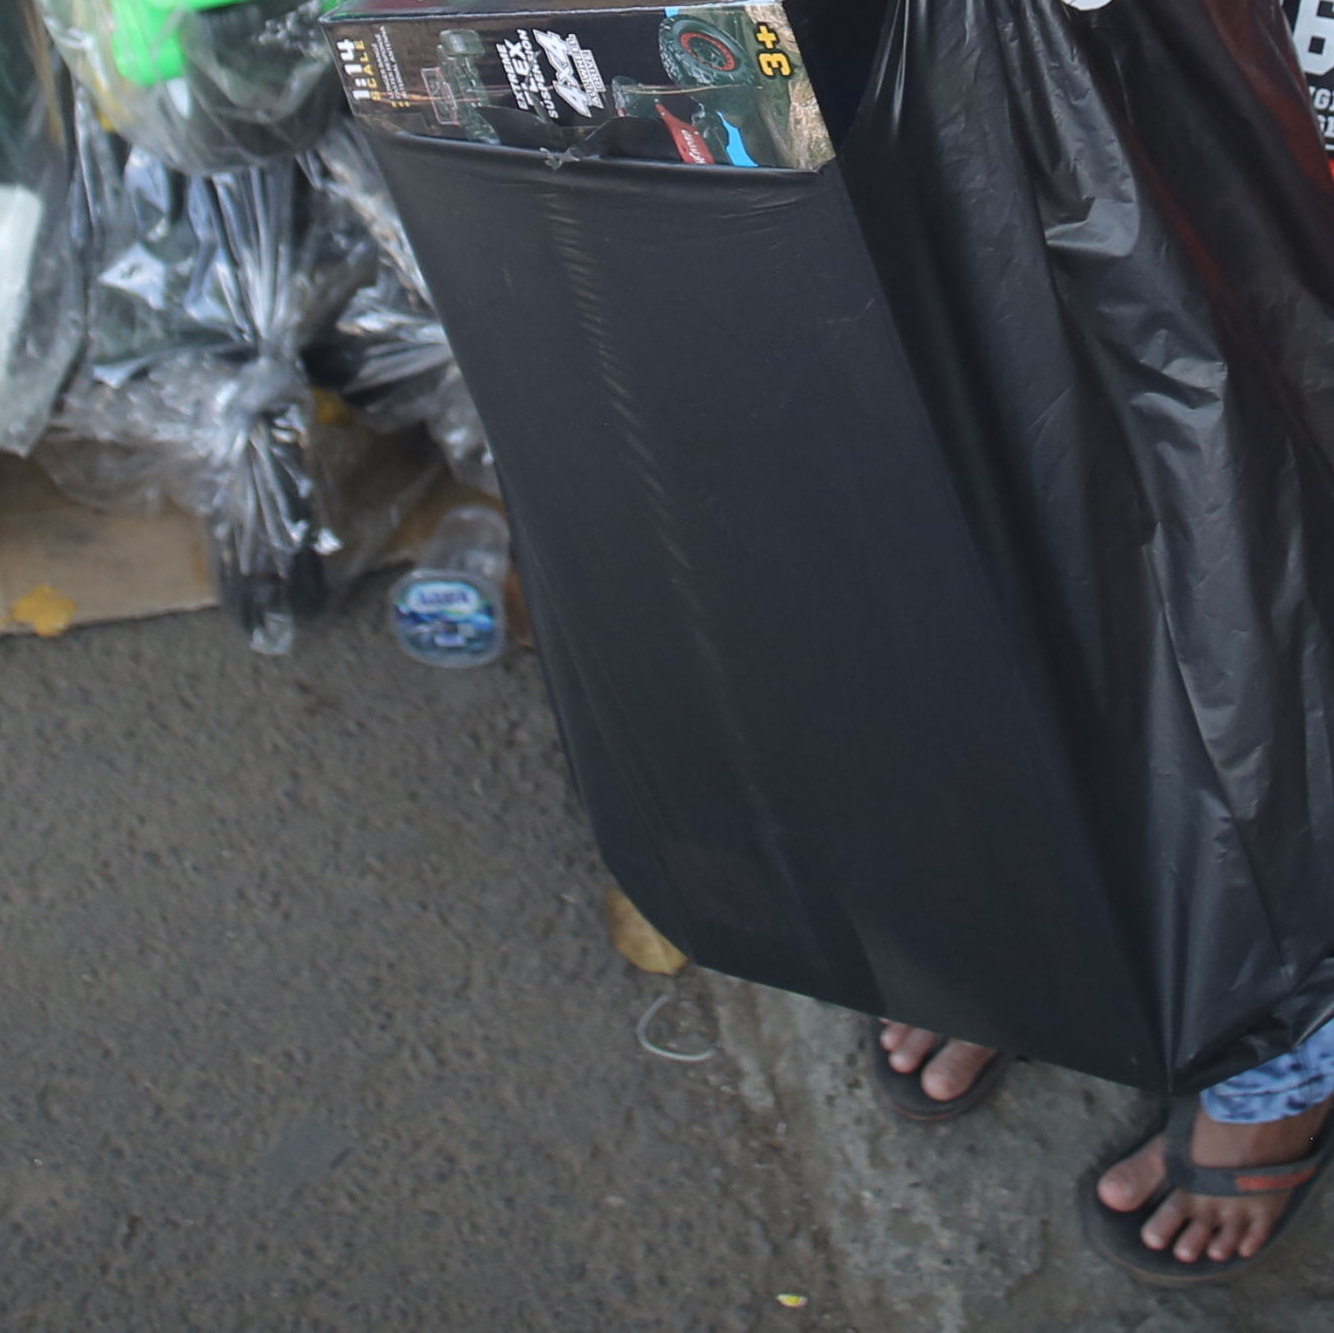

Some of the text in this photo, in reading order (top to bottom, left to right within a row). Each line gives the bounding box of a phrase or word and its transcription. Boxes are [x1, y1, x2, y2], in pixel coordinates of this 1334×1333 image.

[337, 39, 370, 100] 1:14
[354, 41, 380, 101] SCALE
[496, 44, 529, 110] EXTREME
[581, 50, 606, 92] DRIVE
[756, 25, 791, 77] 3+
